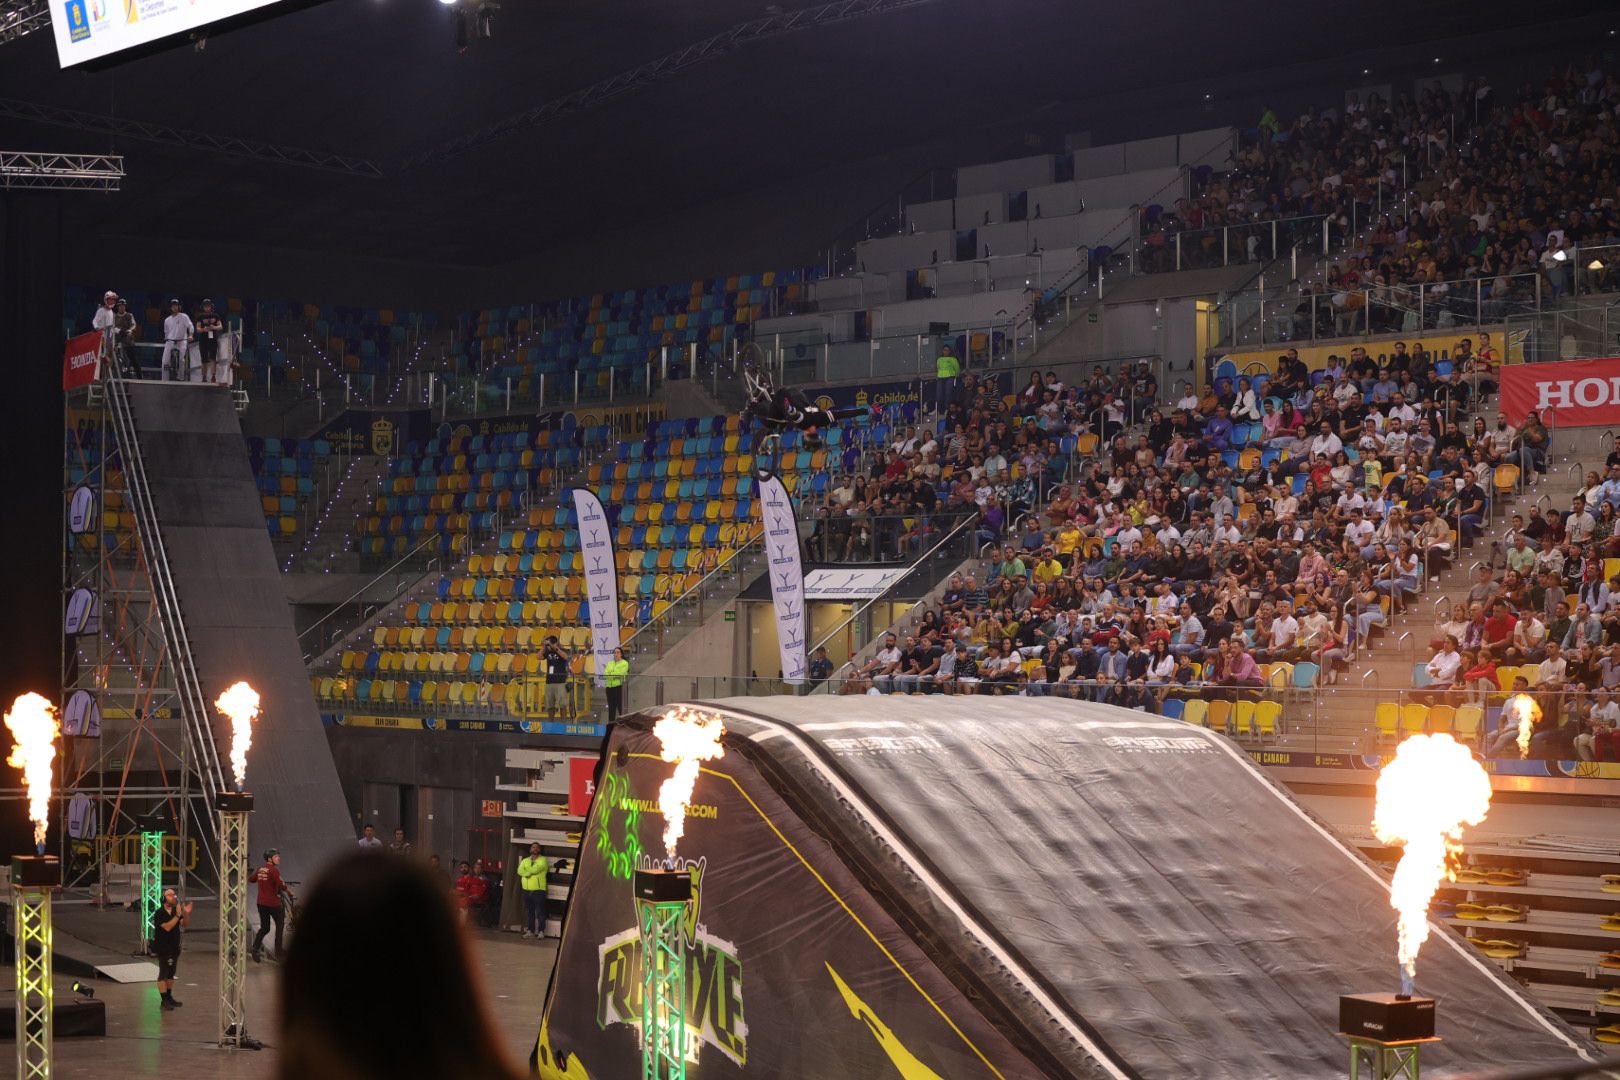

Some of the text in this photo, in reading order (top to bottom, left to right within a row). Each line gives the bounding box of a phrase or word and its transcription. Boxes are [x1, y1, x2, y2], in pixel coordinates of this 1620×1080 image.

[70, 350, 97, 370] HONDA
[873, 393, 906, 403] Cabildo
[1263, 752, 1290, 764] CANARIA
